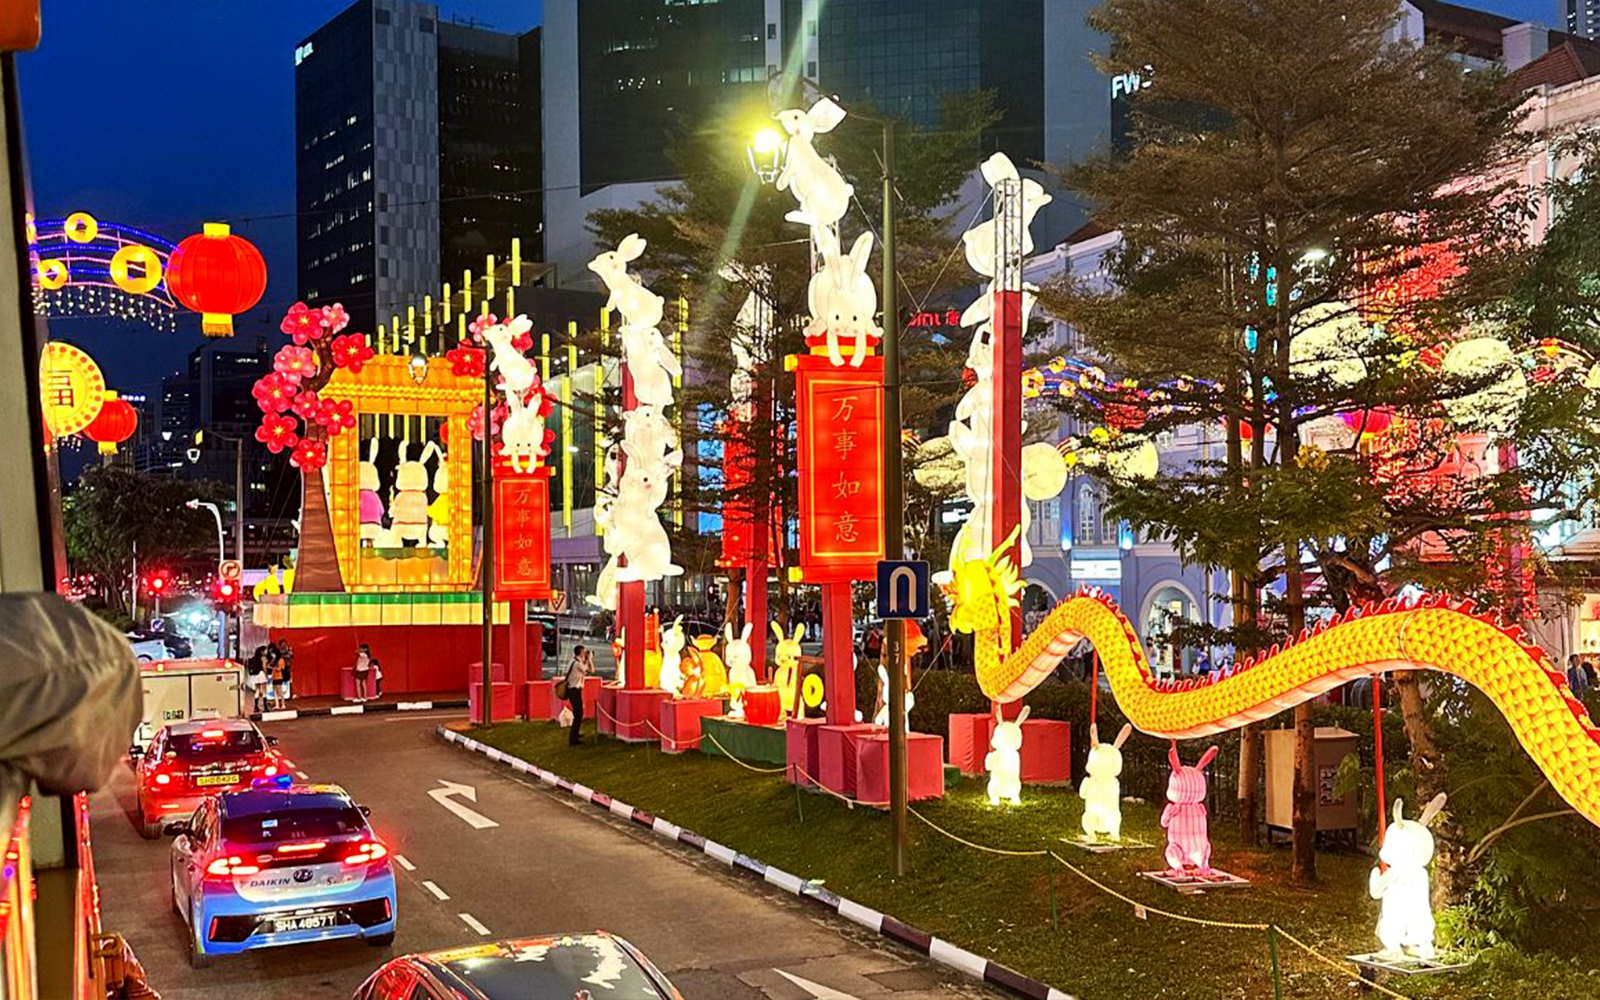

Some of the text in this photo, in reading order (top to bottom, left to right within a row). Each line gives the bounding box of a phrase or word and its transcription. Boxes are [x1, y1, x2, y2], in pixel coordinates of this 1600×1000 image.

[832, 395, 860, 543] 万事如意
[514, 488, 533, 576] 万事如意
[250, 877, 291, 887] DAIKIN
